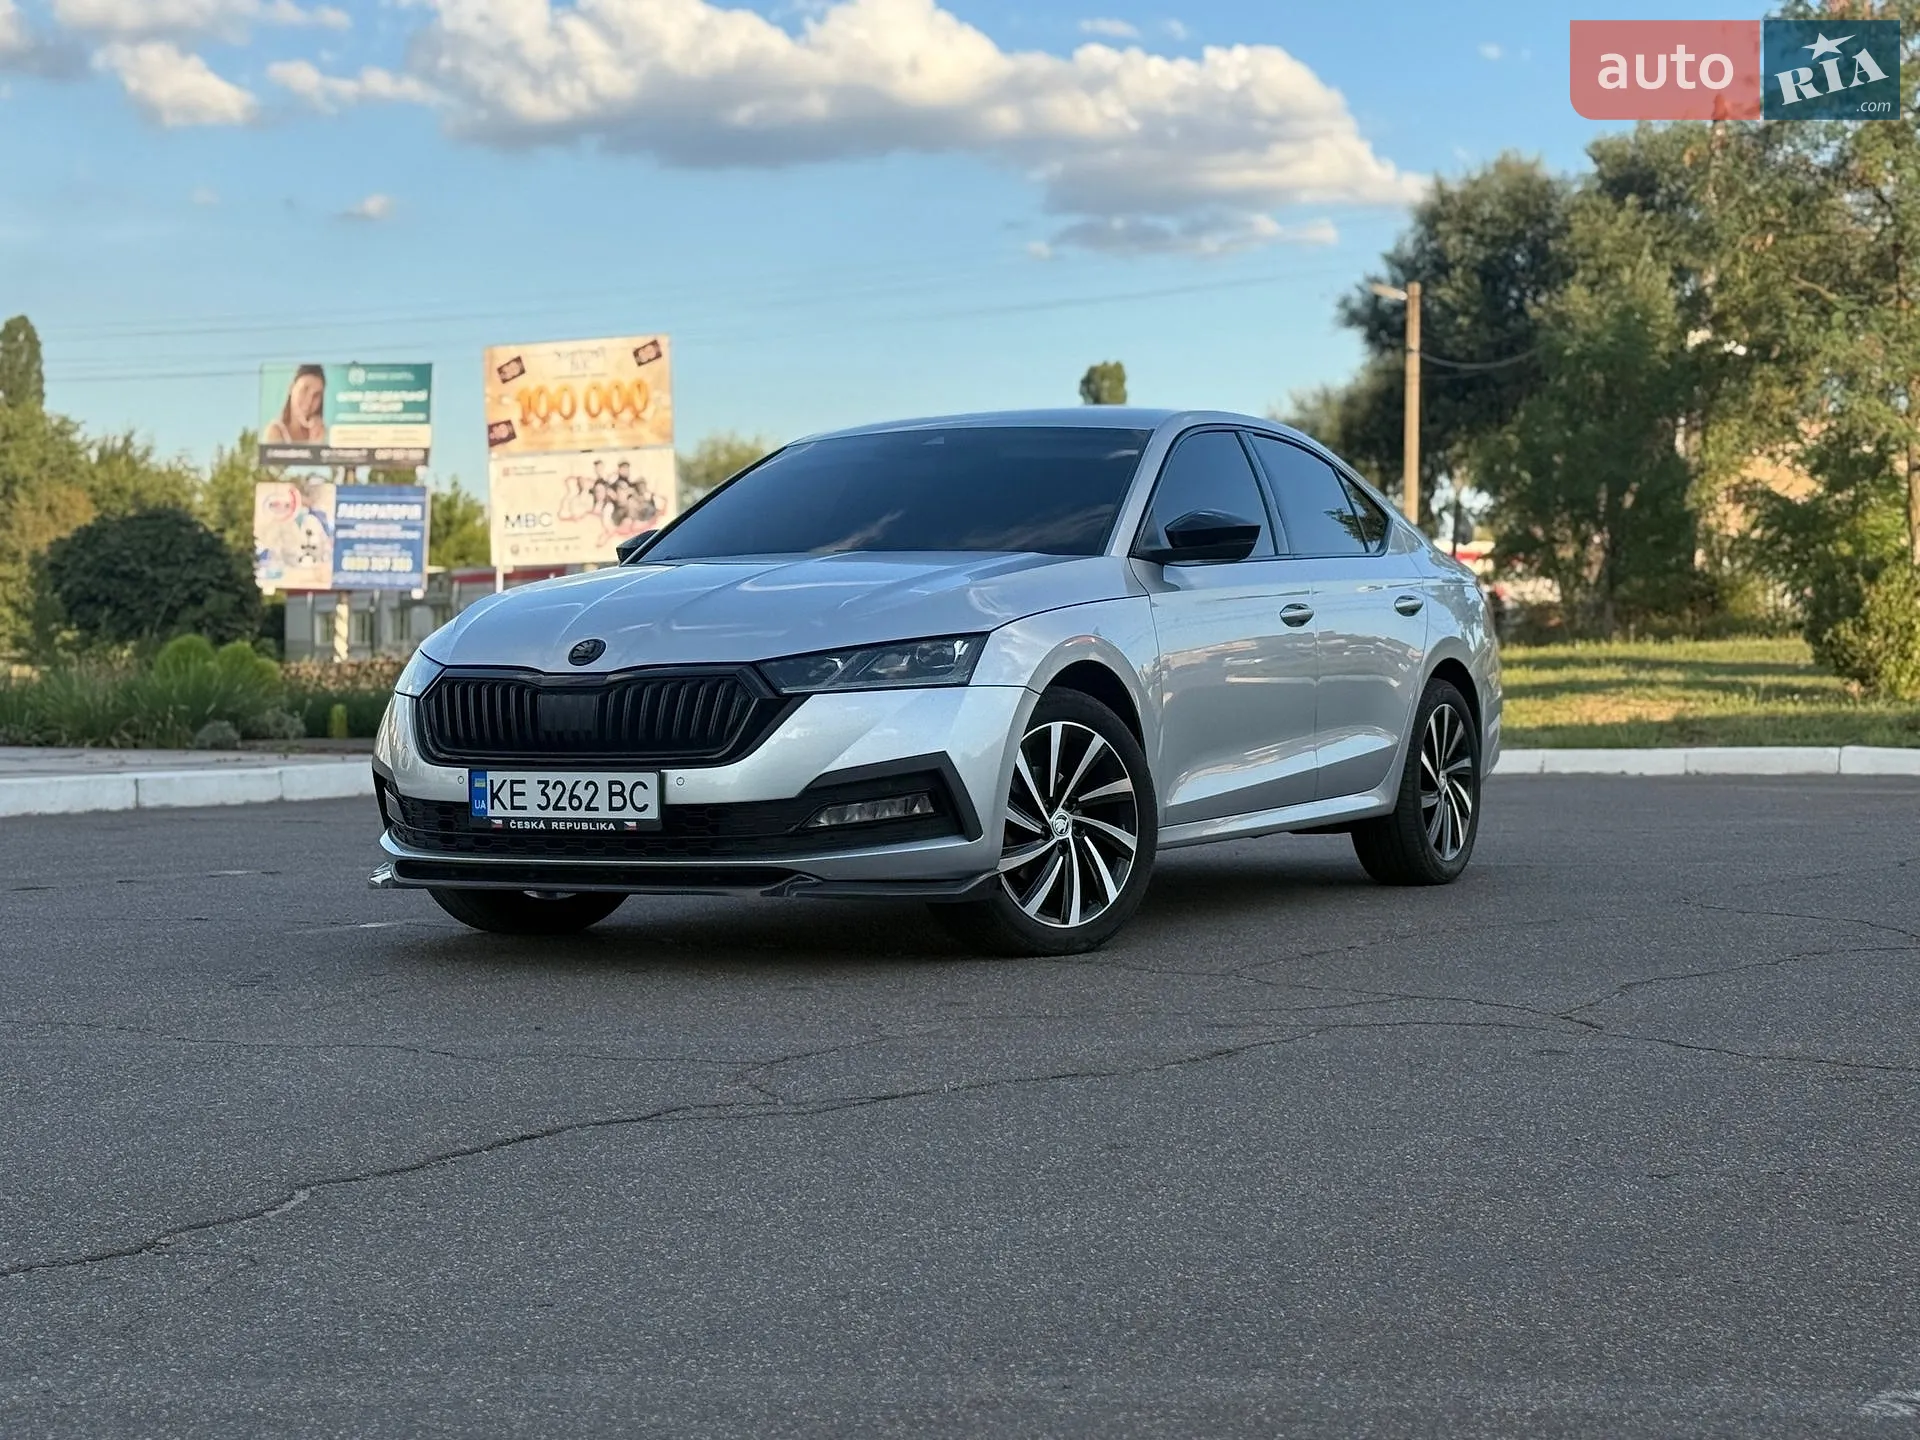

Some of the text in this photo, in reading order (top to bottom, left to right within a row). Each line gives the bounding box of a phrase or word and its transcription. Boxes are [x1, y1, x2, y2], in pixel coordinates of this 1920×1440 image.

[489, 779, 649, 813] KE 3262 BC
[474, 800, 487, 810] UA
[509, 819, 616, 831] ČESKÁ REPUBLIKA
